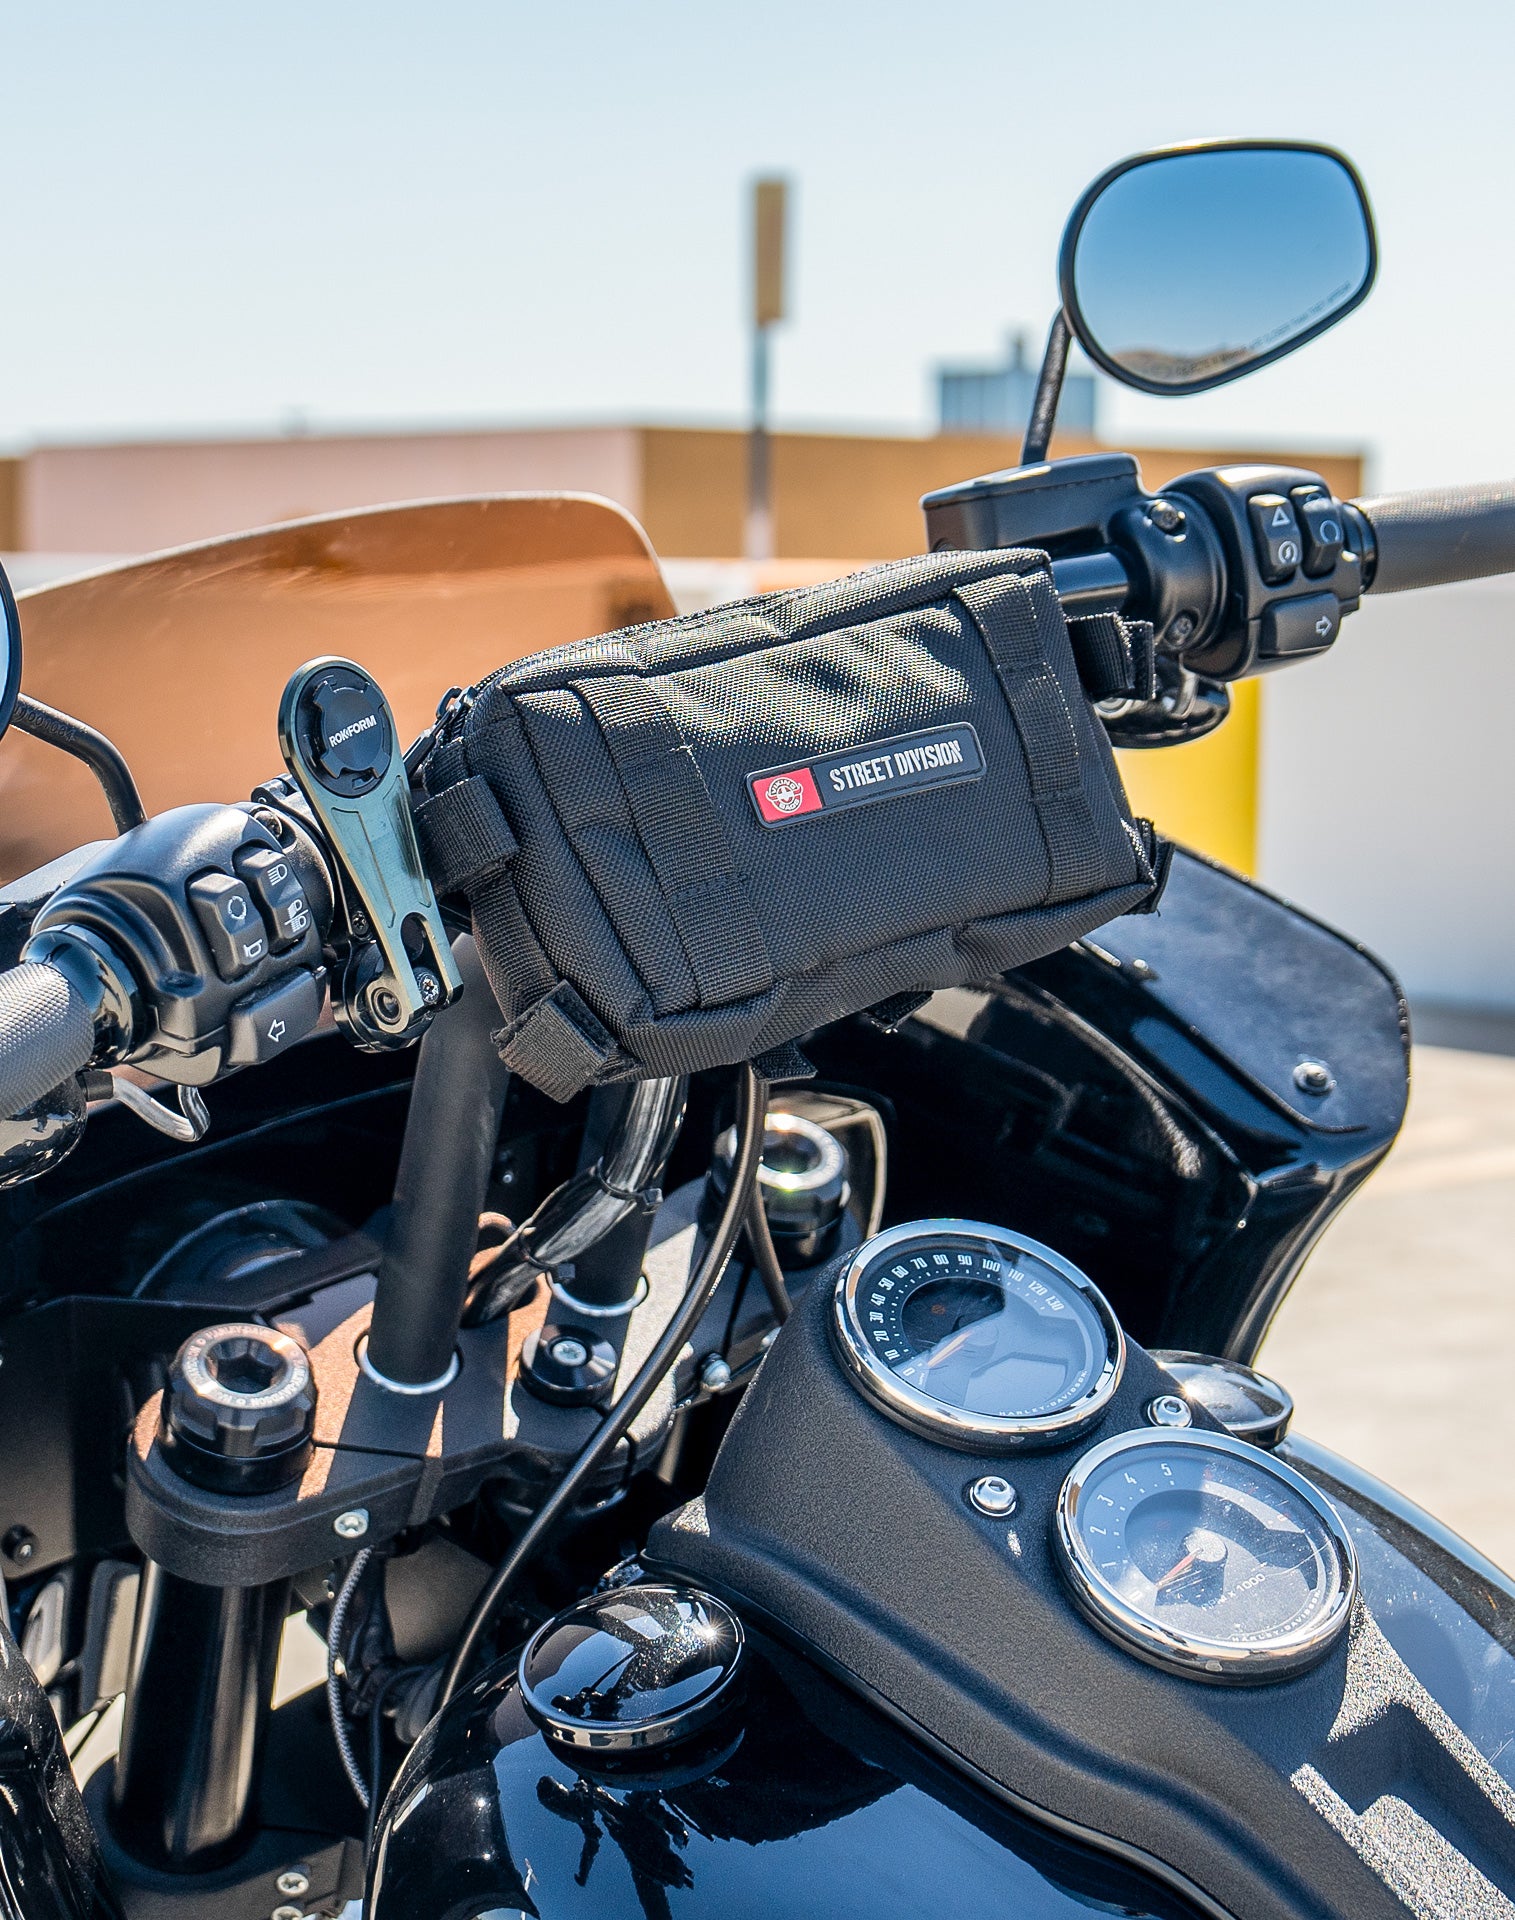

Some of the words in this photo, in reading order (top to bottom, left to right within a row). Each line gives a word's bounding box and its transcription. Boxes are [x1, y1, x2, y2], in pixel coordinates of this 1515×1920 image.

[328, 715, 377, 748] ROKFORM
[829, 755, 892, 792] STREET
[892, 739, 963, 776] DIVISION
[771, 779, 797, 794] VIKING
[779, 799, 800, 811] BAGS
[910, 1257, 928, 1270] 70
[933, 1253, 949, 1266] 80
[957, 1254, 973, 1267] 90
[982, 1258, 1001, 1273] 100
[891, 1265, 909, 1279] 60
[1007, 1268, 1025, 1283] 110
[877, 1278, 895, 1291] 50
[1028, 1280, 1049, 1297] 120
[870, 1292, 887, 1307] 40
[1045, 1295, 1065, 1312] 130
[869, 1312, 885, 1324] 30
[874, 1330, 890, 1343] 20
[884, 1349, 901, 1361] 10
[902, 1366, 914, 1377] 0
[1160, 1463, 1173, 1477] 5
[1124, 1472, 1137, 1485] 4
[1097, 1494, 1115, 1507] 3
[1090, 1526, 1107, 1536] 2
[1236, 1573, 1266, 1592] 1000
